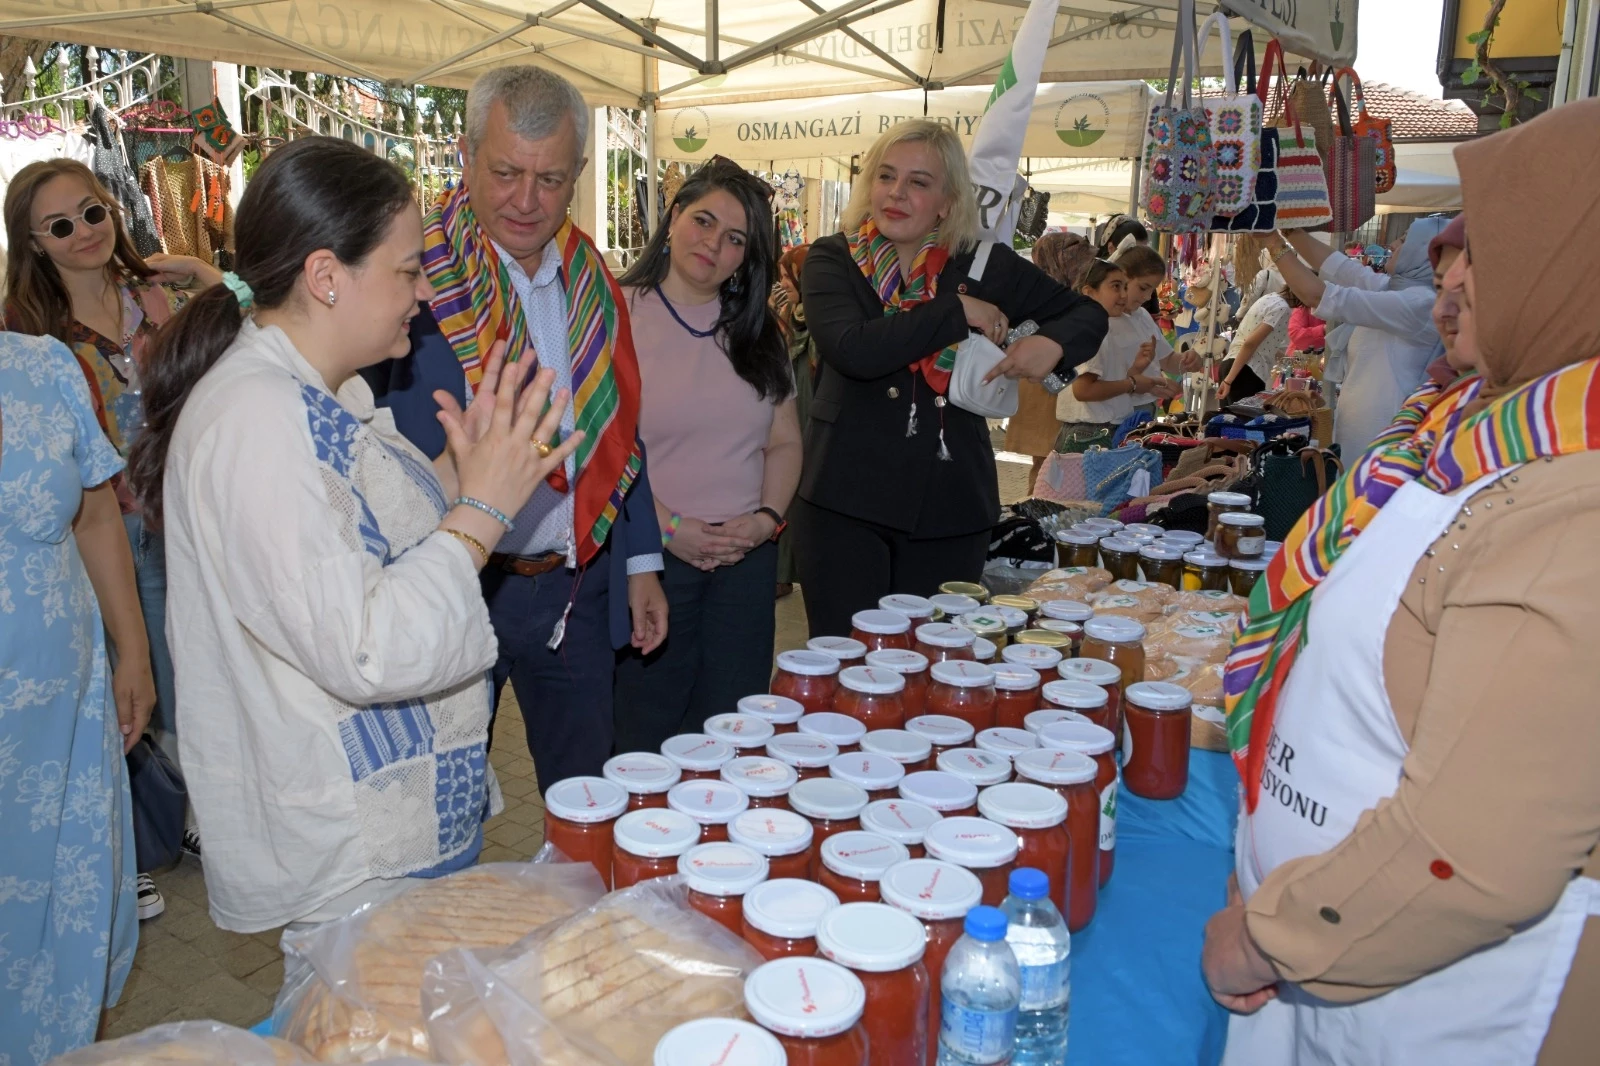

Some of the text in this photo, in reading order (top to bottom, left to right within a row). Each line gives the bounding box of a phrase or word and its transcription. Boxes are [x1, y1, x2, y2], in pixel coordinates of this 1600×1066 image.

[737, 110, 861, 142] OSMANGAZİ
[1266, 724, 1295, 775] ER
[1260, 762, 1328, 827] SYONU
